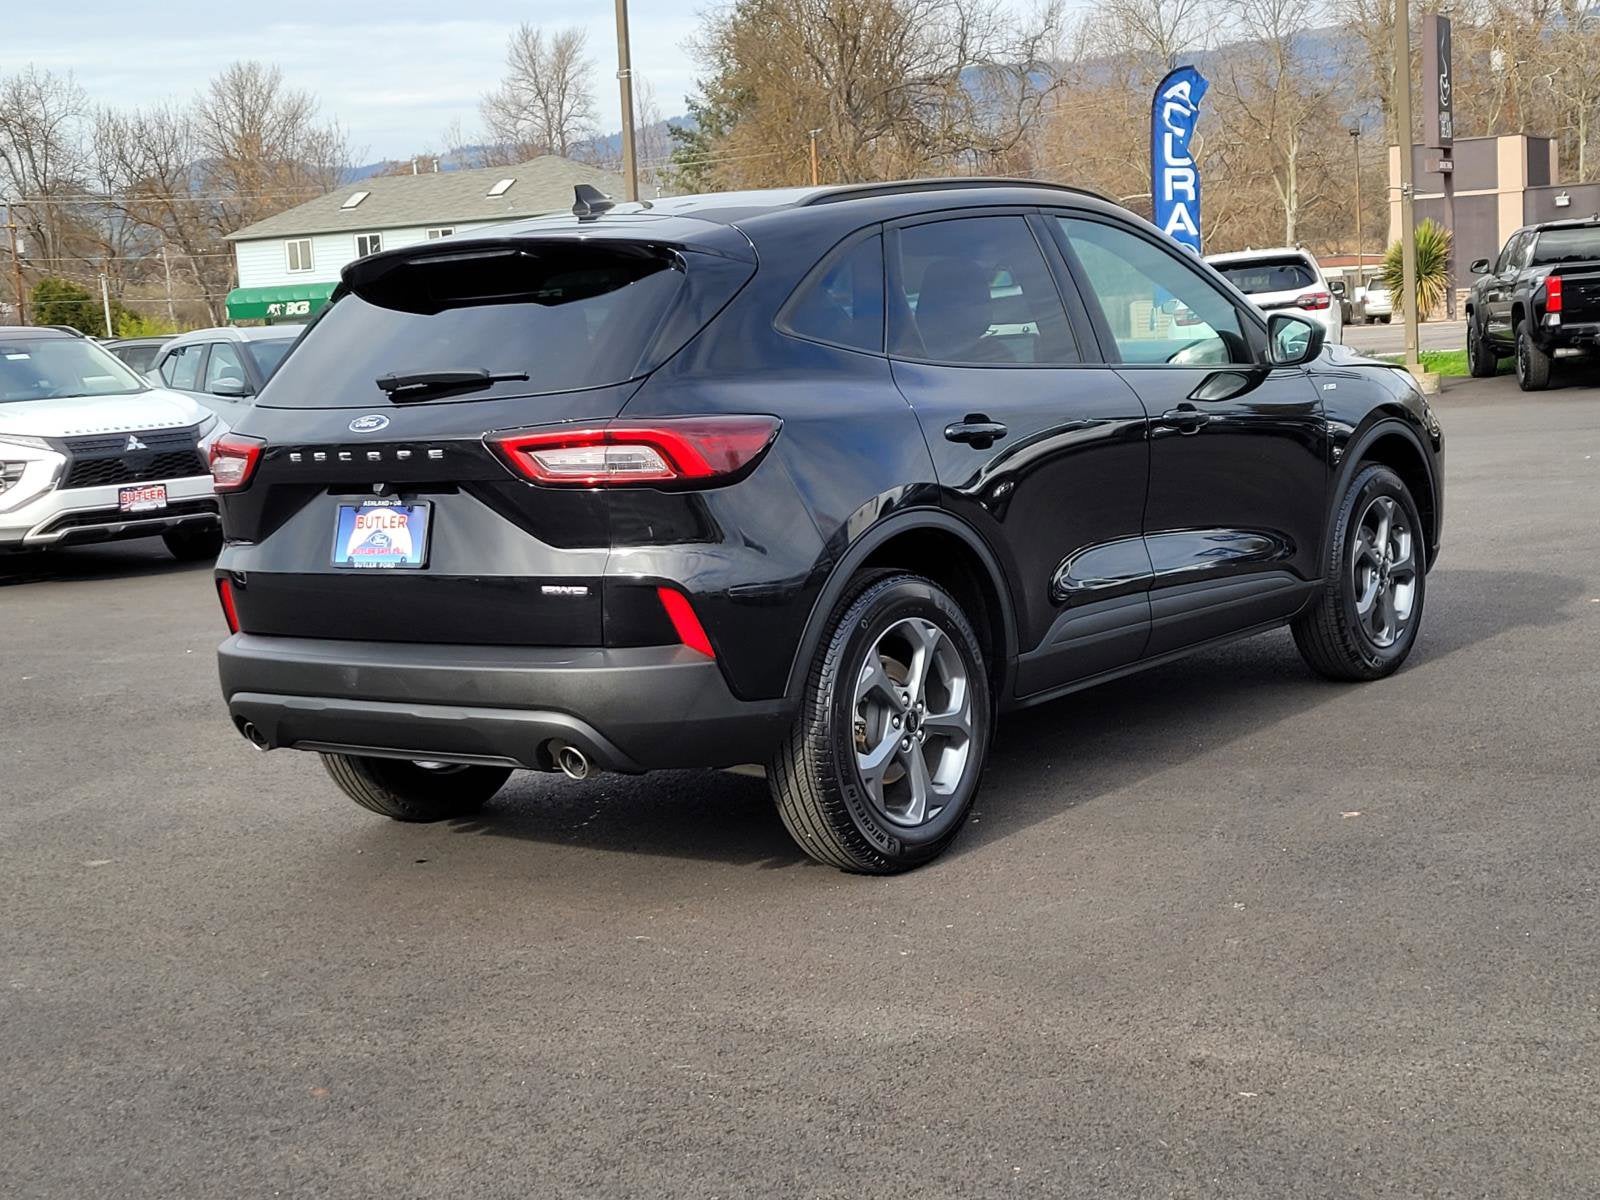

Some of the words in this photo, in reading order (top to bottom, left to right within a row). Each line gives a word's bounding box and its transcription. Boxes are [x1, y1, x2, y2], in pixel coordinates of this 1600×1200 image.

[289, 449, 444, 462] ESCAPE
[121, 488, 163, 503] BUTLER
[356, 515, 407, 529] BUTLER
[848, 788, 887, 844] MICHELIN
